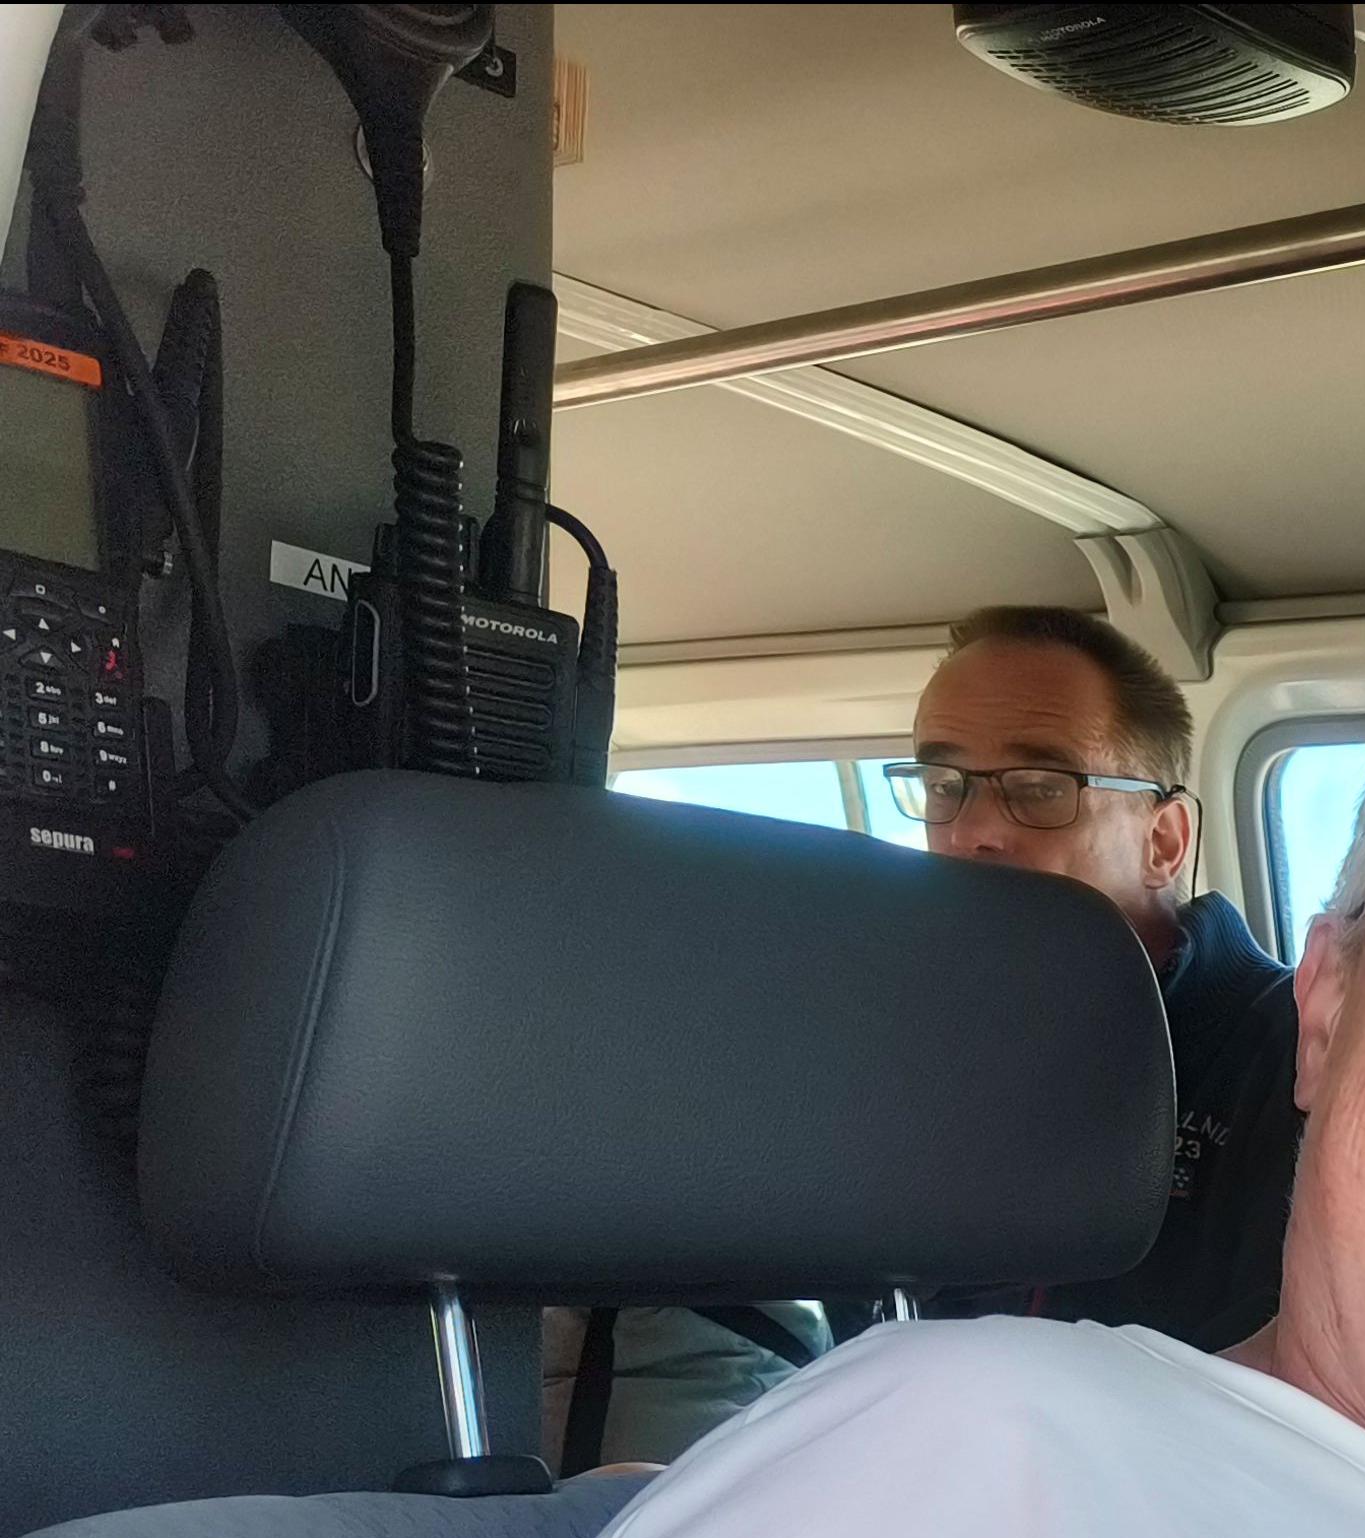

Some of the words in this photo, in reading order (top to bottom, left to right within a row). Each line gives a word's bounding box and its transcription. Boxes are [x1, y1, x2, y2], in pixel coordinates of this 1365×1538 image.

[17, 343, 71, 371] 2025
[303, 558, 353, 602] AN
[461, 614, 559, 645] MOTOROLA
[30, 827, 94, 853] sepura
